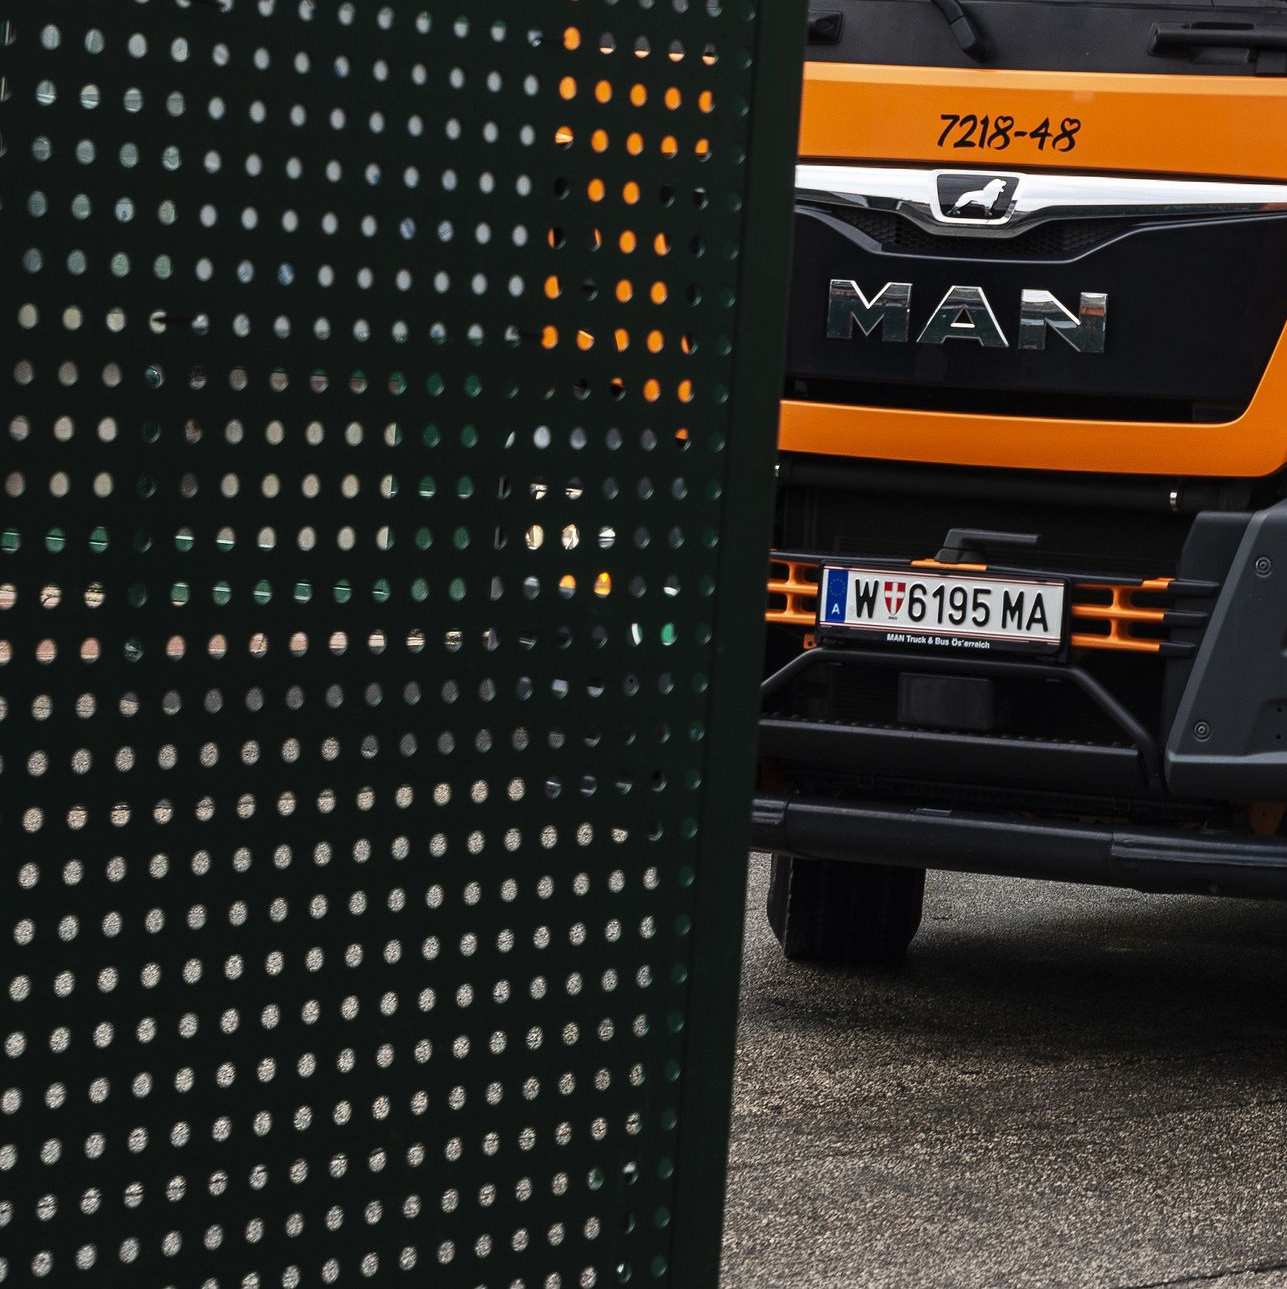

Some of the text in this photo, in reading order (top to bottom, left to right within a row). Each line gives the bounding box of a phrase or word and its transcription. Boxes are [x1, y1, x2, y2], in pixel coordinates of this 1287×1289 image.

[937, 113, 1081, 152] 7218-48
[826, 278, 1109, 353] MAN
[831, 603, 840, 615] A
[855, 578, 1049, 633] W 6195 MA
[887, 633, 905, 642] MAN
[906, 634, 928, 644] Truck
[928, 636, 934, 644] &
[935, 636, 949, 646] Bus
